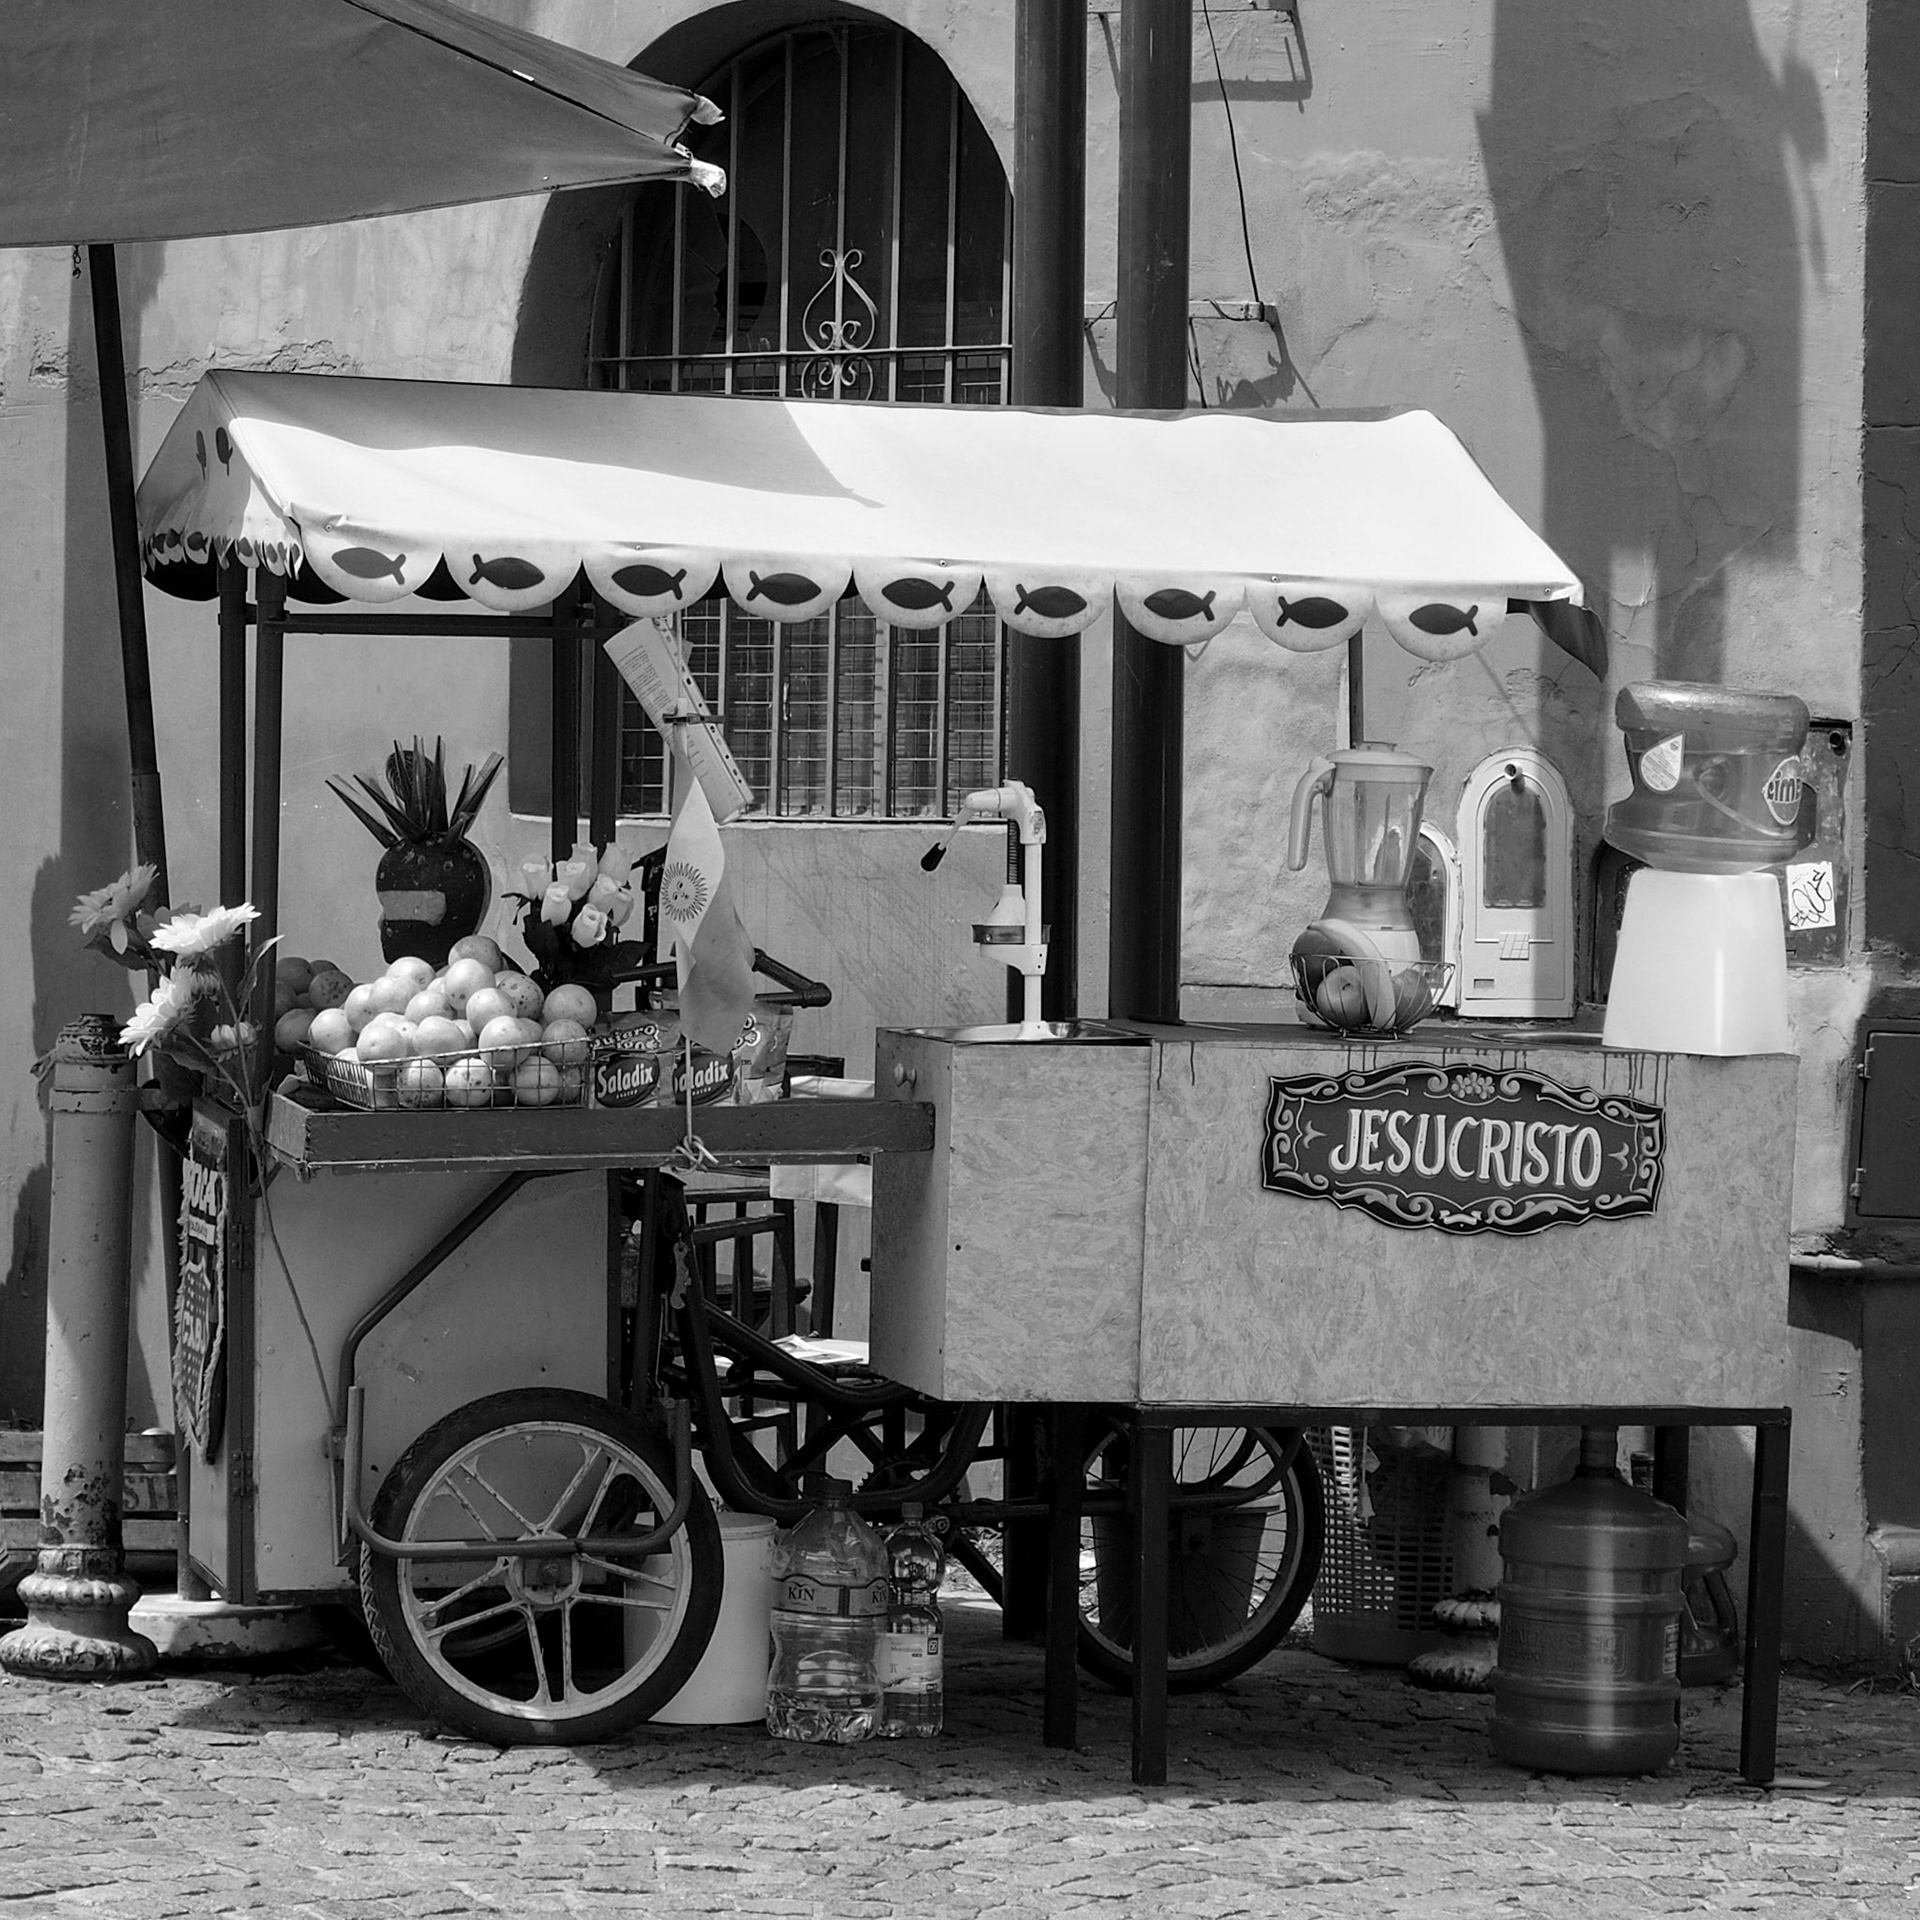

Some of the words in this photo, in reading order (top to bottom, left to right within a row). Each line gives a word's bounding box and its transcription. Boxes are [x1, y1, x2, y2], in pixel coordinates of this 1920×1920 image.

[597, 1062, 654, 1099] Saladix
[674, 1060, 729, 1094] aladix
[1328, 1108, 1602, 1189] JESUCRISTO
[787, 1586, 815, 1602] KIN
